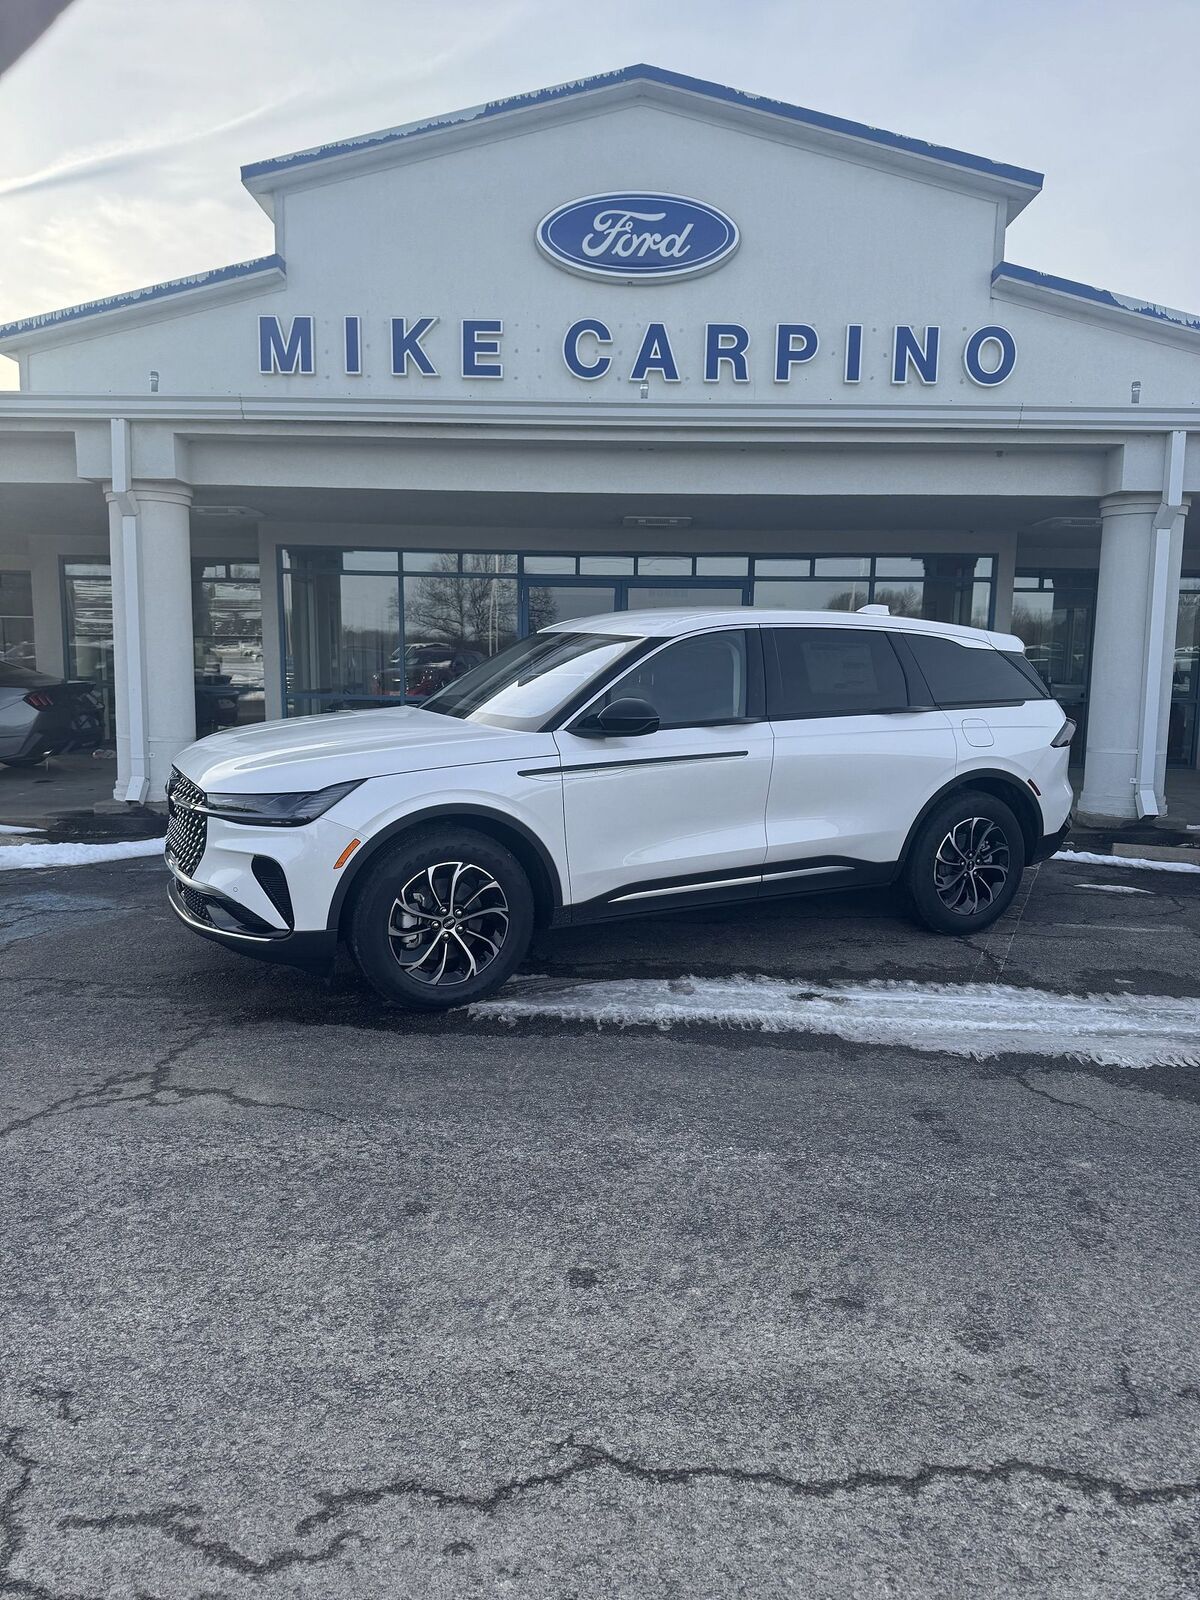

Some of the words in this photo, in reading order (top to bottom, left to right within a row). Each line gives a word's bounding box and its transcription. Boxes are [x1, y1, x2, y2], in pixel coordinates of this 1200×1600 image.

[582, 209, 695, 258] Ford
[258, 315, 503, 379] MIKE
[563, 318, 1018, 387] CARPINO
